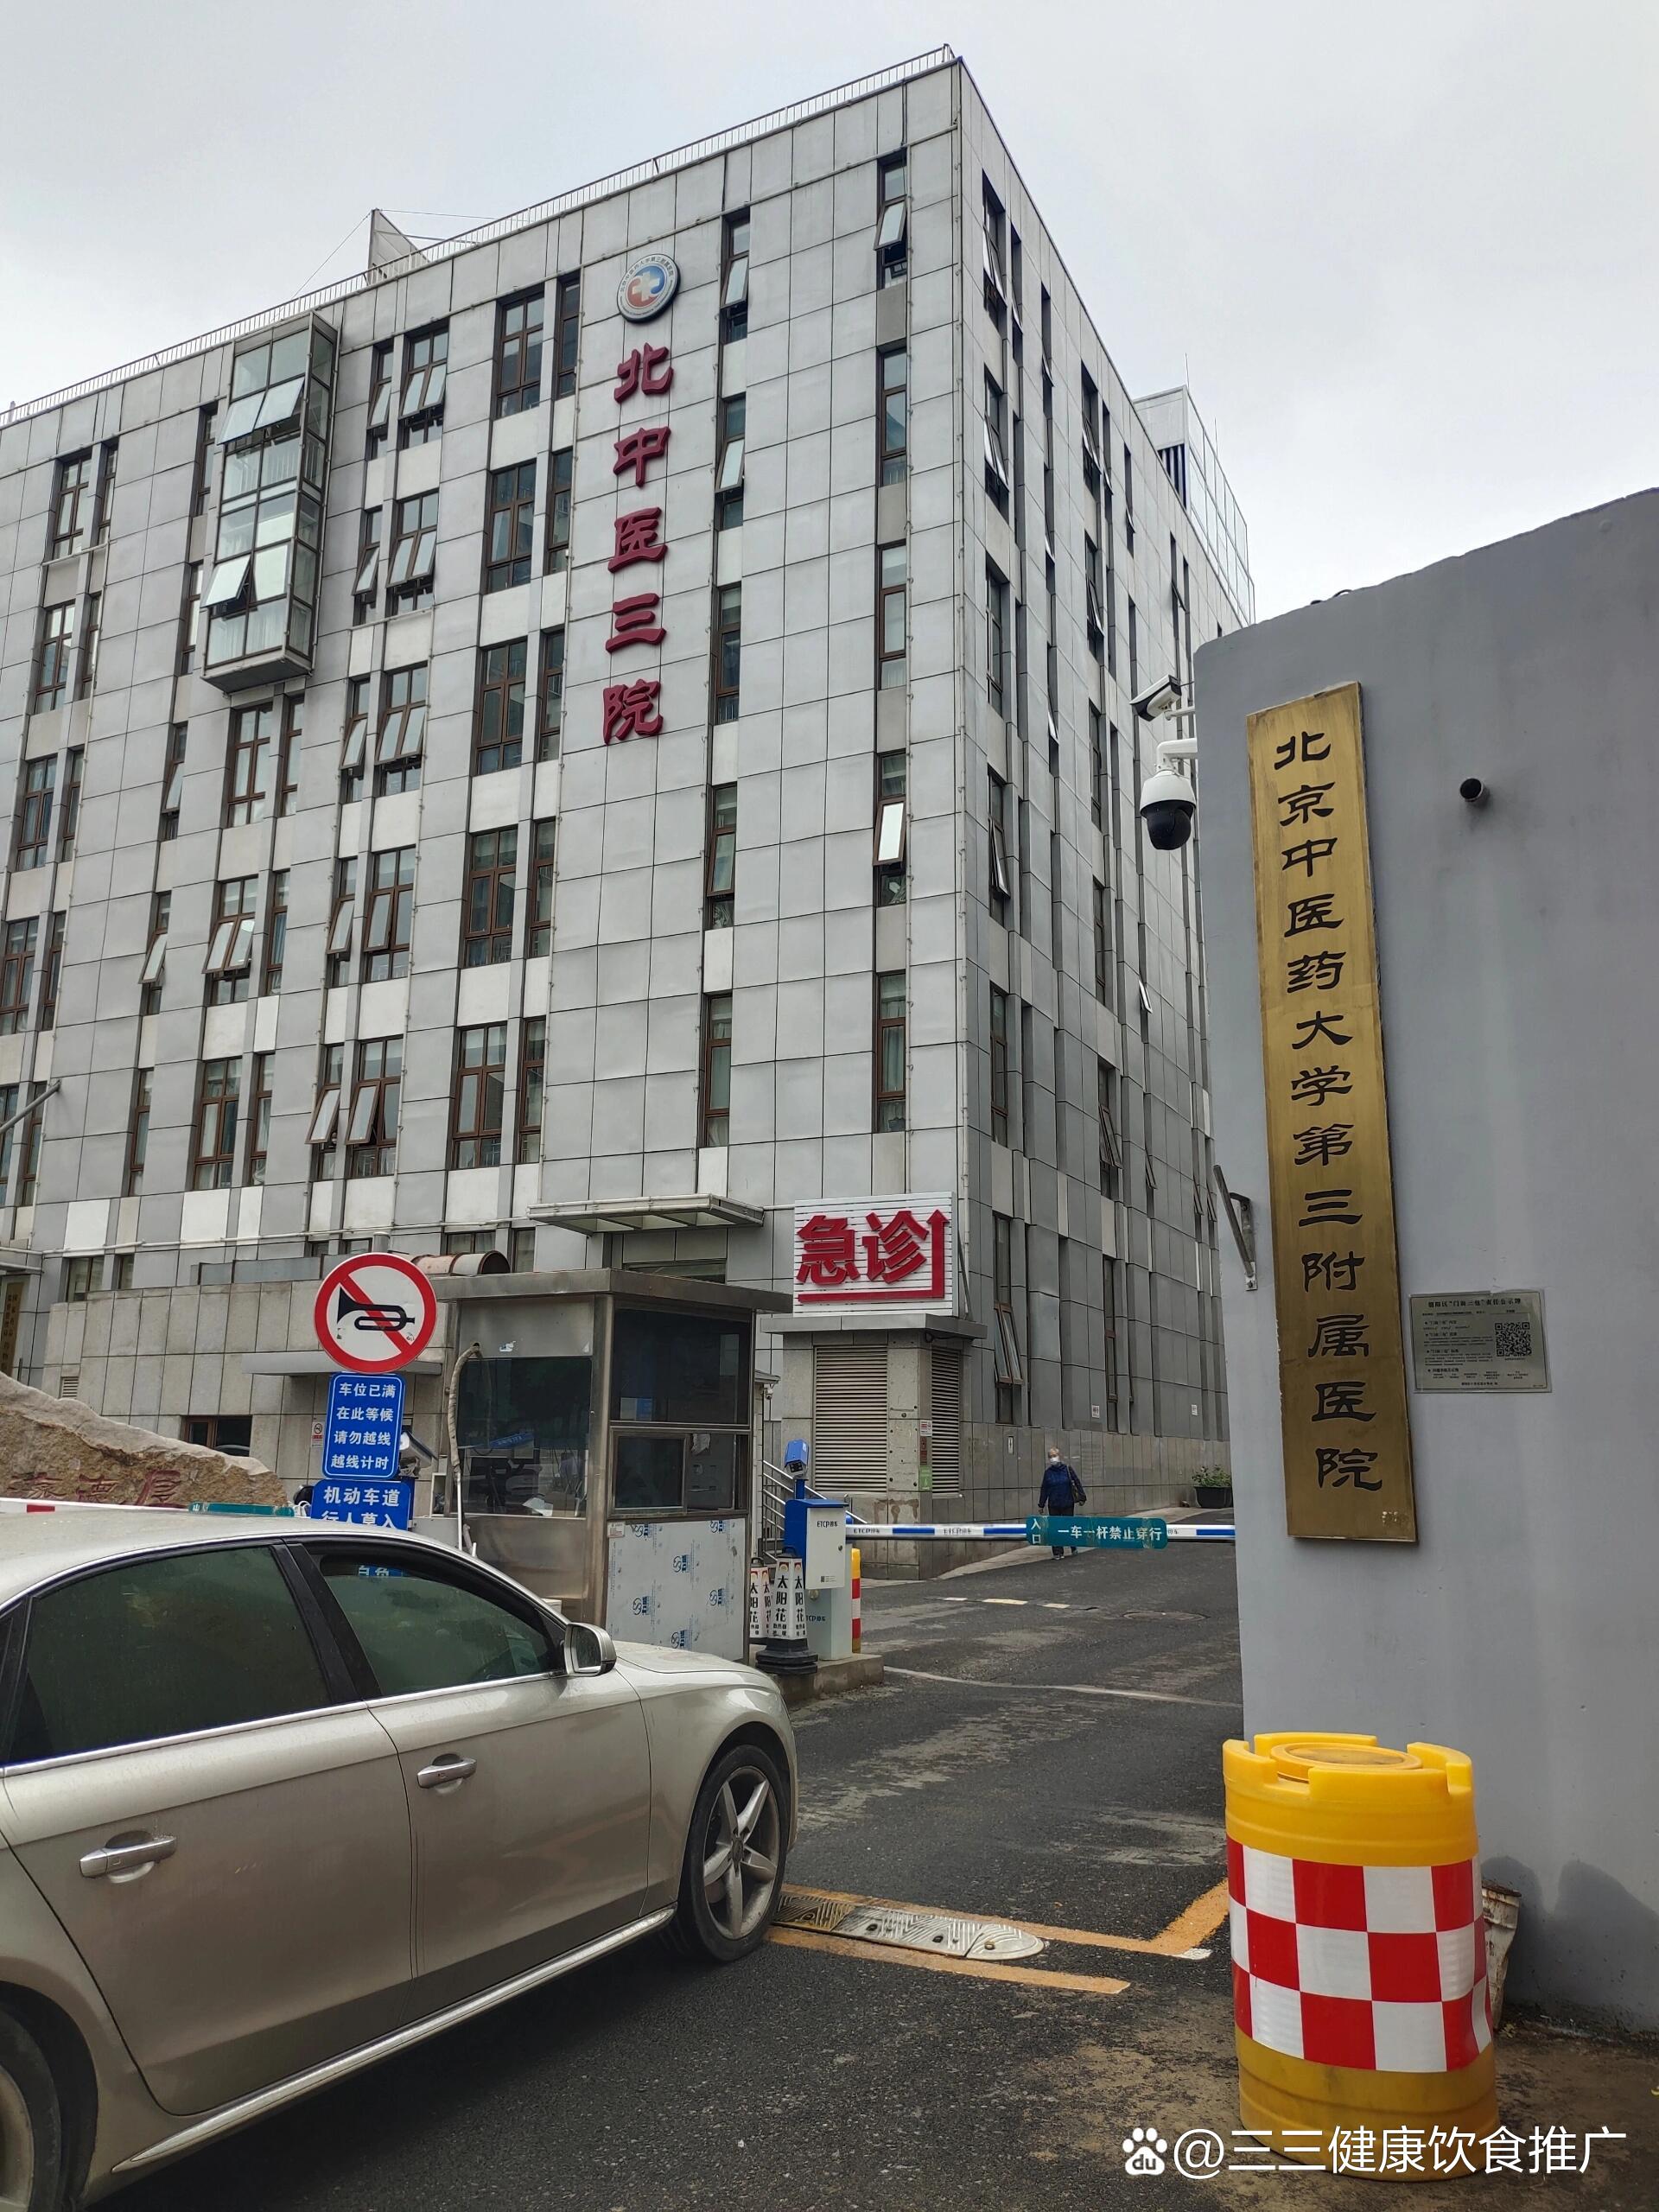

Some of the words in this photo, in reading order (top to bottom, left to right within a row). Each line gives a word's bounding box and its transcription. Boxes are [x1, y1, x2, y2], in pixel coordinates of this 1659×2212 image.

[602, 342, 674, 745] 北中医三院
[1274, 729, 1382, 1494] 北京中医药大学第三附属医院
[796, 1210, 930, 1287] 急诊
[339, 1382, 397, 1399] 车位已满
[336, 1407, 394, 1422] 在此等候
[334, 1430, 391, 1446] 请勿越线
[330, 1454, 389, 1470] 越线计时
[323, 1485, 401, 1507] 机动车道
[1031, 1517, 1042, 1545] 入口
[1057, 1524, 1162, 1541] 一车一杆禁止穿行
[776, 1575, 789, 1622] 太阳花
[794, 1575, 804, 1622] 太阳花
